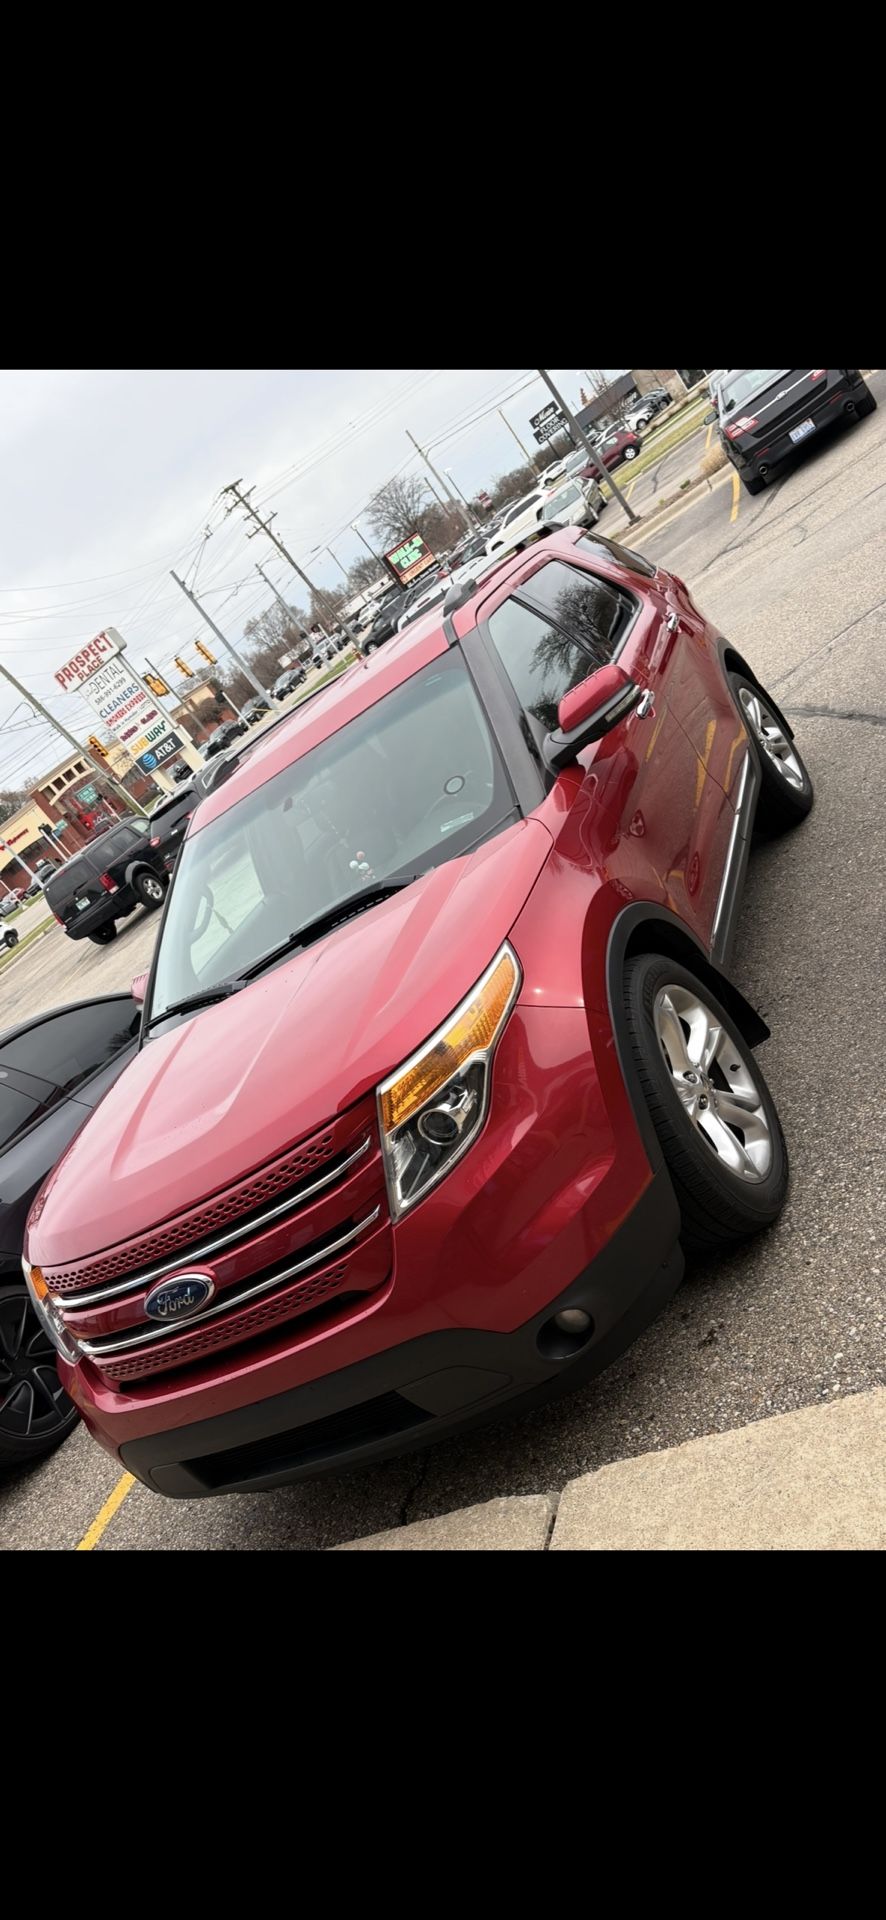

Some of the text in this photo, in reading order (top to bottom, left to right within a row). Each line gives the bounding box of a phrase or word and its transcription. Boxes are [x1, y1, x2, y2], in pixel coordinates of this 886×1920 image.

[539, 418, 568, 443] COVERING
[540, 416, 561, 433] FLOOR
[54, 631, 114, 690] PROSPECT
[77, 655, 105, 681] PLACE
[89, 663, 124, 694] DENTAL
[99, 682, 139, 718] CLEANERS
[130, 720, 166, 756] SUBWAY
[154, 738, 176, 760] AT&T
[156, 1286, 195, 1316] Ford
